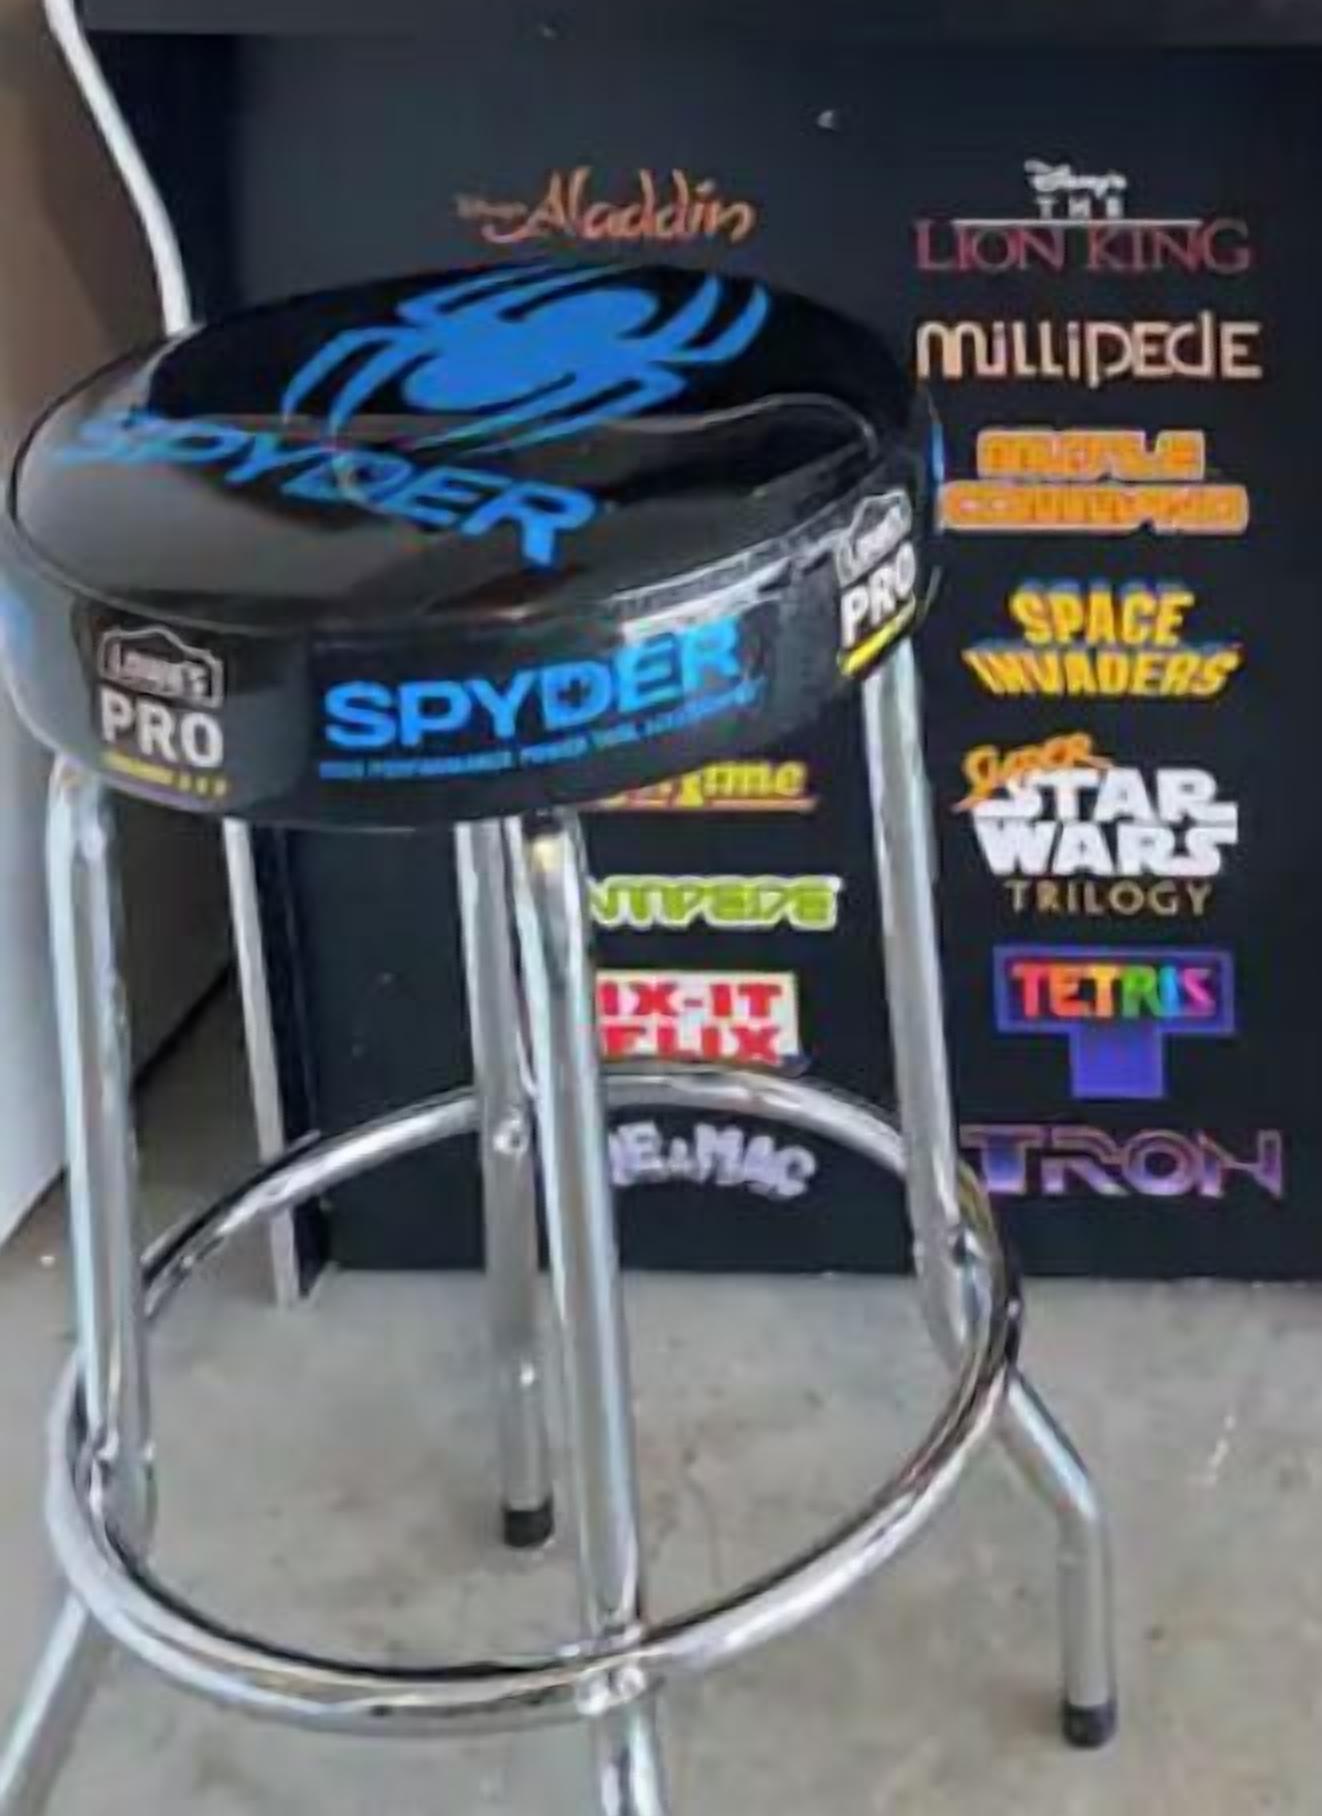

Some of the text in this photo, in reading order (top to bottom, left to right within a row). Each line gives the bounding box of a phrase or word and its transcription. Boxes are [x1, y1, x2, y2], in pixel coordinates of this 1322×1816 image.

[481, 164, 757, 244] Aladdin
[914, 219, 1253, 275] LION KING
[54, 408, 600, 569] SPYDER
[840, 541, 917, 651] PRO
[1008, 578, 1195, 646] SPACE
[324, 614, 742, 750] SPYDER
[961, 640, 1244, 698] INVADERS
[100, 685, 225, 769] PRO
[972, 766, 1239, 822] STAR
[972, 818, 1239, 877] WARS
[1004, 879, 1214, 916] TRILOGY
[600, 981, 782, 1017] IX-IT
[1011, 961, 1217, 1020] TETRIS
[957, 1123, 1283, 1199] TRON
